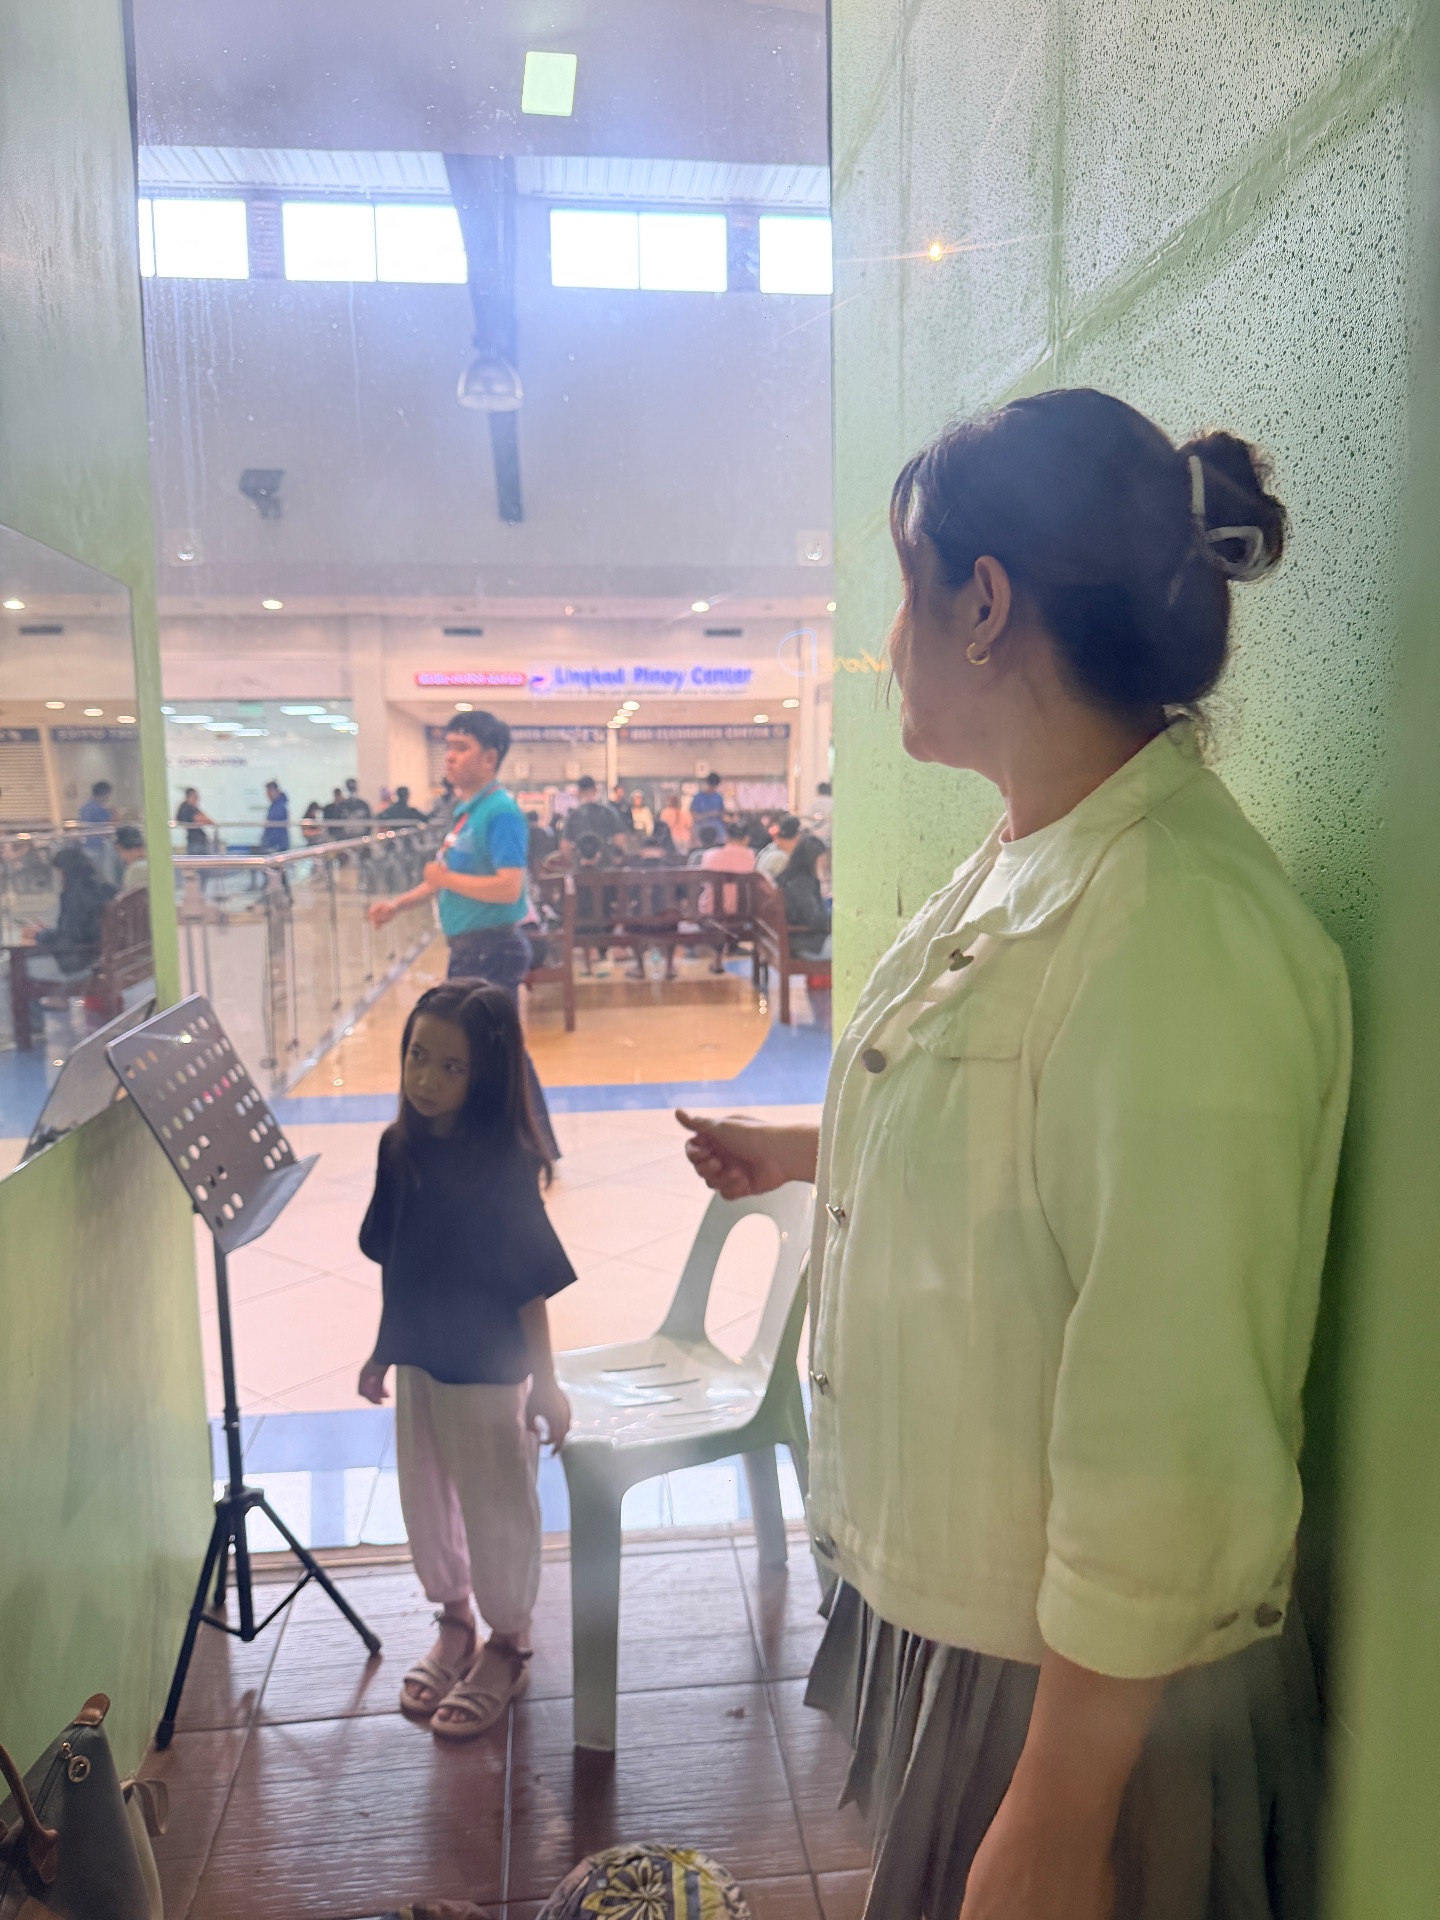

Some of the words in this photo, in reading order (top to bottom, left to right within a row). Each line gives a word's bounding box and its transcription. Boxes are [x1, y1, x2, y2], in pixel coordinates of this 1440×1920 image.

[555, 666, 625, 688] Lingkod
[633, 666, 684, 690] Pinoy
[691, 666, 752, 685] Center
